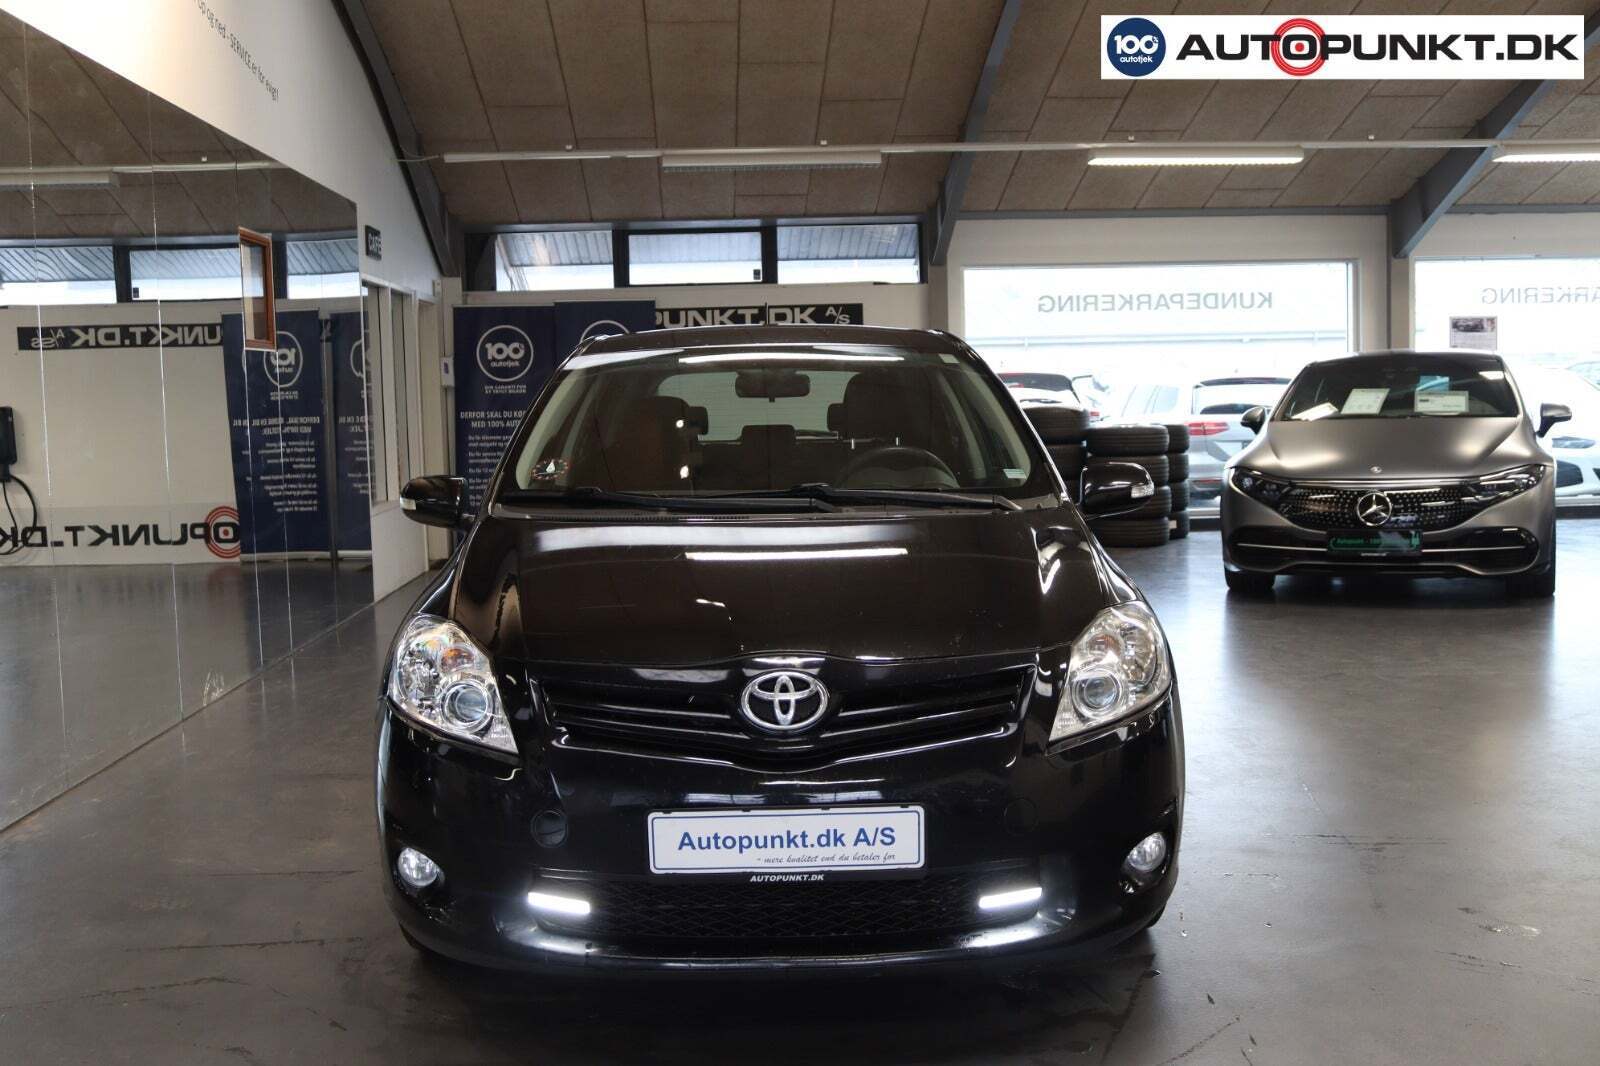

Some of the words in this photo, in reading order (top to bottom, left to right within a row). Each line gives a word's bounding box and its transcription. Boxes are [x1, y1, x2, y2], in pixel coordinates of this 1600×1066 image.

[230, 33, 251, 69] SERVICE
[825, 306, 850, 325] A/S
[460, 411, 485, 419] DERFOR
[486, 410, 502, 418] SKAL
[503, 410, 512, 418] DU
[678, 828, 846, 854] Autopunkt.dk
[853, 827, 896, 847] A/S
[786, 854, 818, 863] kvalitet
[838, 854, 849, 862] du
[852, 852, 880, 861] betaler
[883, 852, 896, 863] for
[750, 874, 825, 882] AUTOPUNKT.DK
